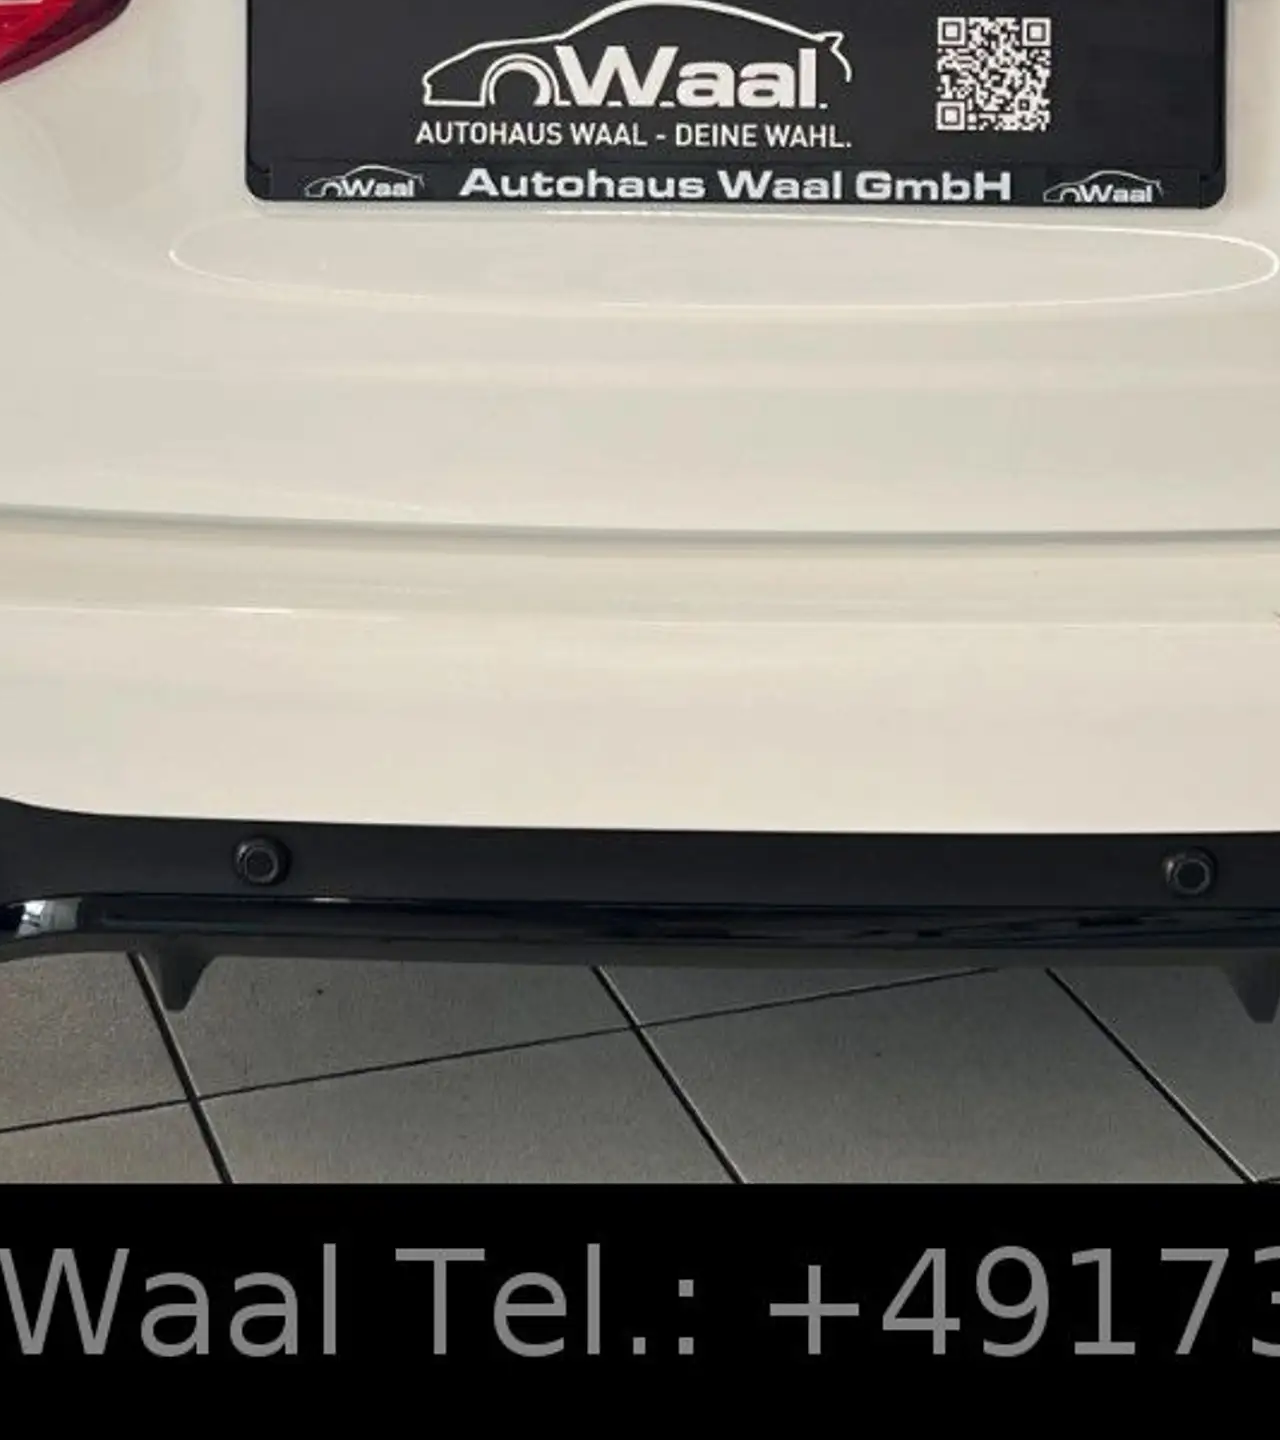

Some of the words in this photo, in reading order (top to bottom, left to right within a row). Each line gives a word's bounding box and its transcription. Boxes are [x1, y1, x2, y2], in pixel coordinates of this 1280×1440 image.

[554, 45, 818, 109] Waal
[415, 121, 563, 146] AUTOHAUS
[569, 122, 648, 147] WAAL
[675, 122, 758, 148] DEINE
[764, 123, 852, 148] WAHL.
[339, 178, 415, 197] Waal
[459, 168, 705, 199] Autohaus
[716, 169, 845, 200] Waal
[855, 170, 1012, 201] GmbH
[1079, 184, 1153, 203] Waal
